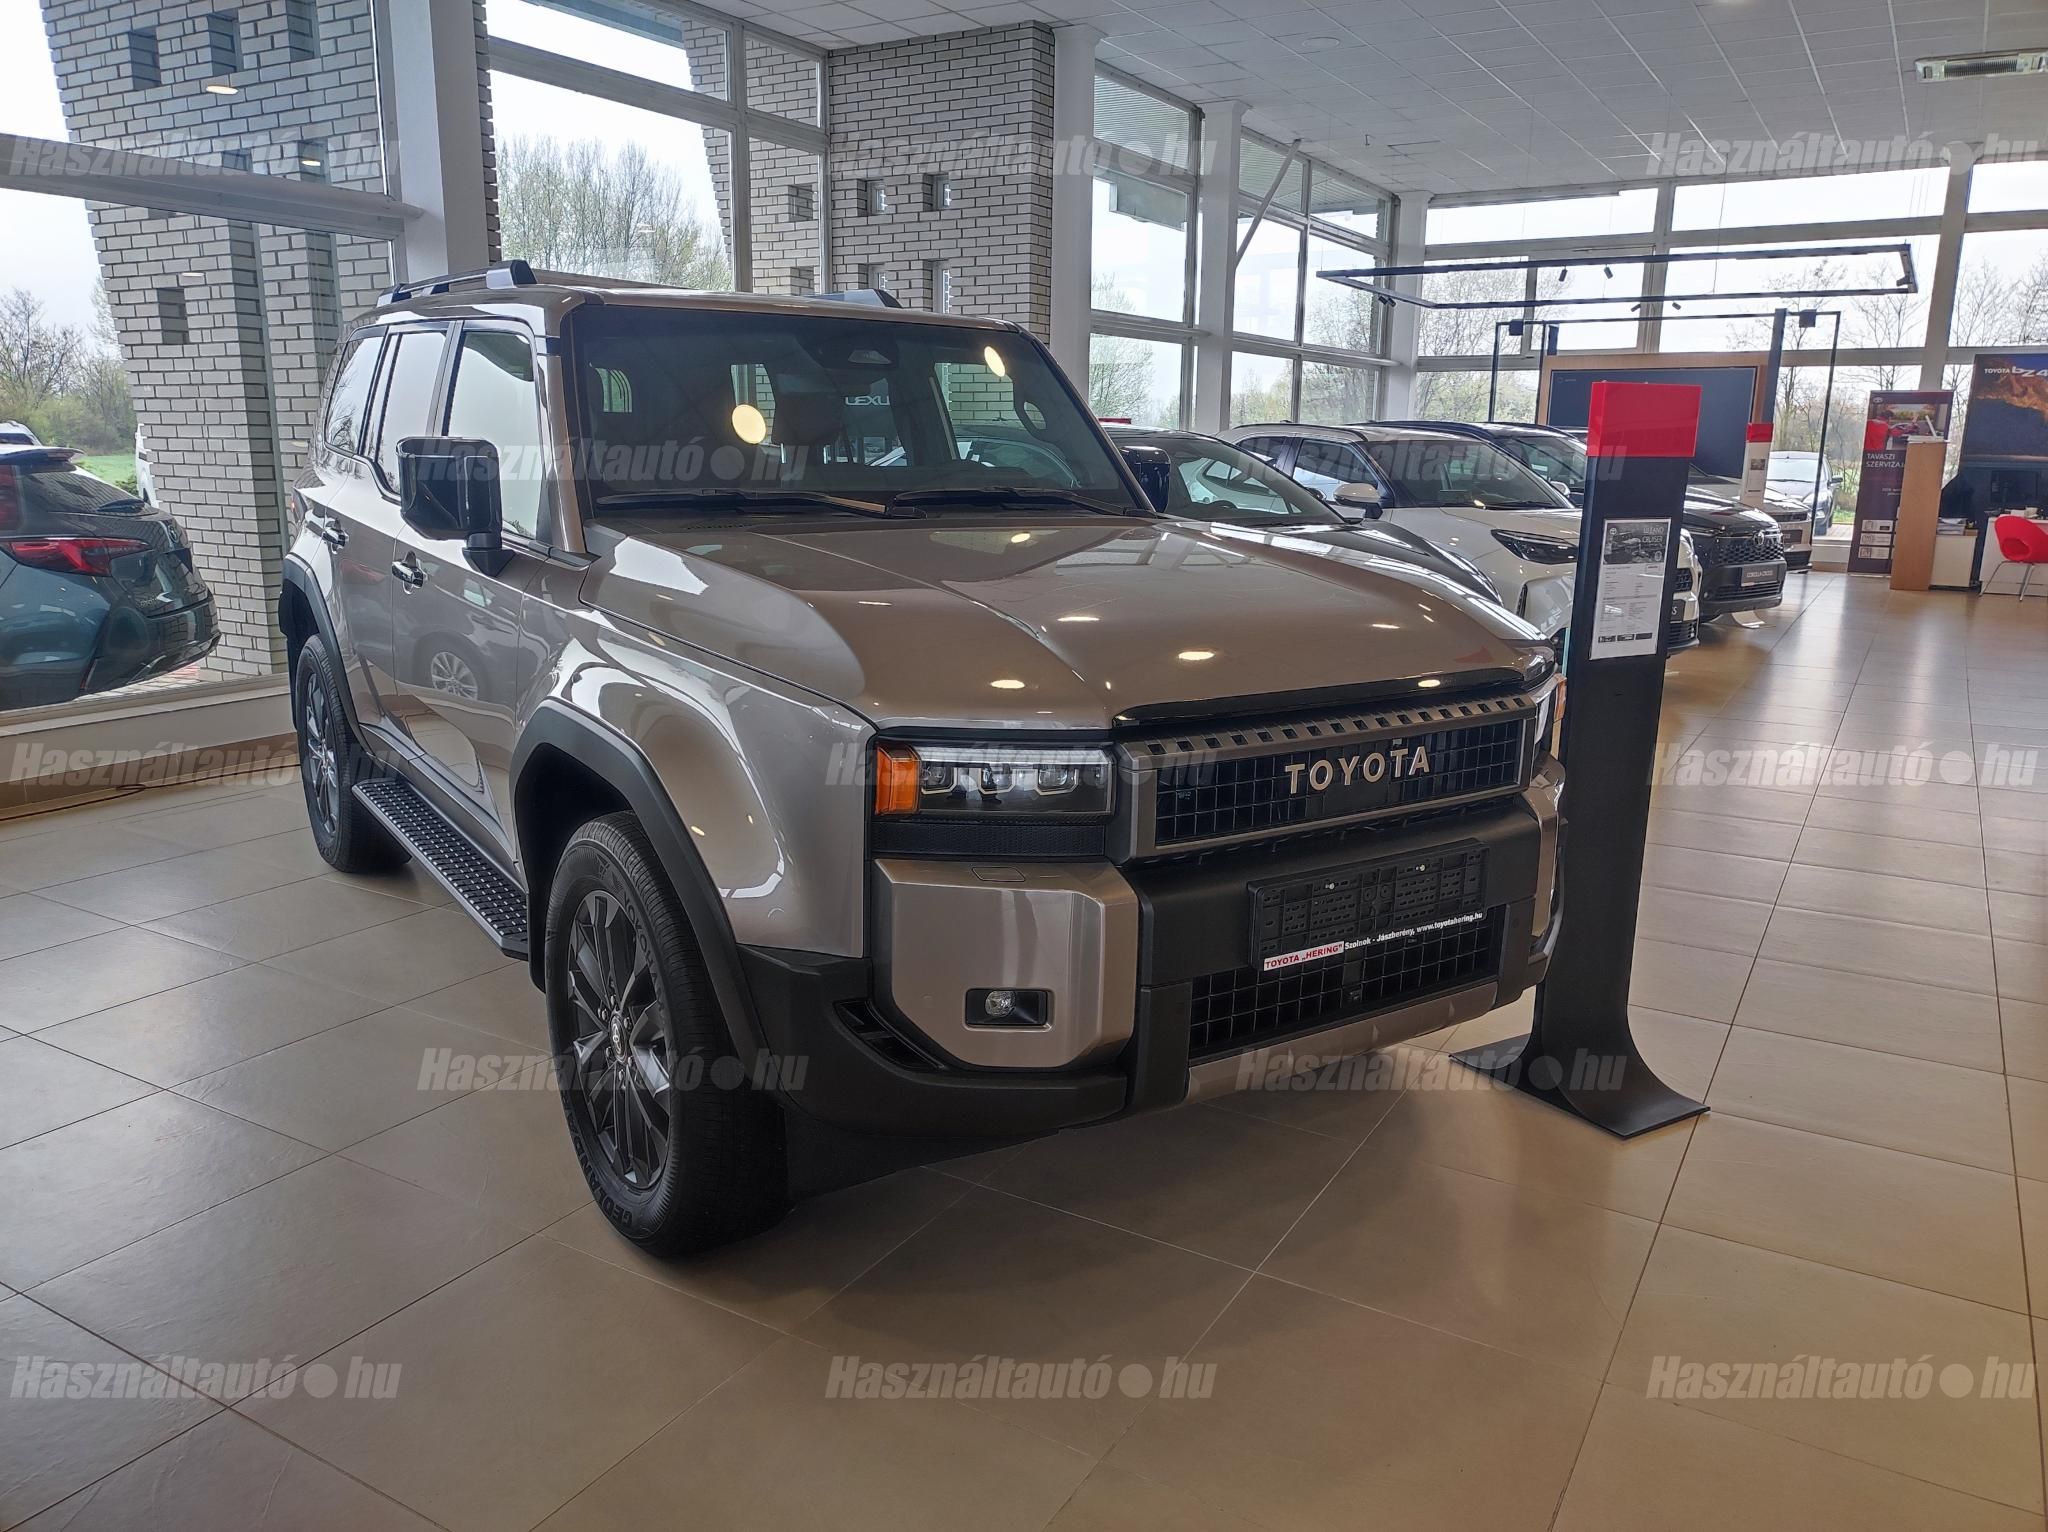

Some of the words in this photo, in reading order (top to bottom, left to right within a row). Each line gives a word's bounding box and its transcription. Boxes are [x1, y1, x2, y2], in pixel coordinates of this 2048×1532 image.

[845, 395, 890, 406] LEXU
[1285, 745, 1430, 794] TOYOTA
[1265, 955, 1300, 969] TOYOTA
[1344, 937, 1372, 950] Szolnok
[1416, 911, 1483, 933] www.toyotahering.hu
